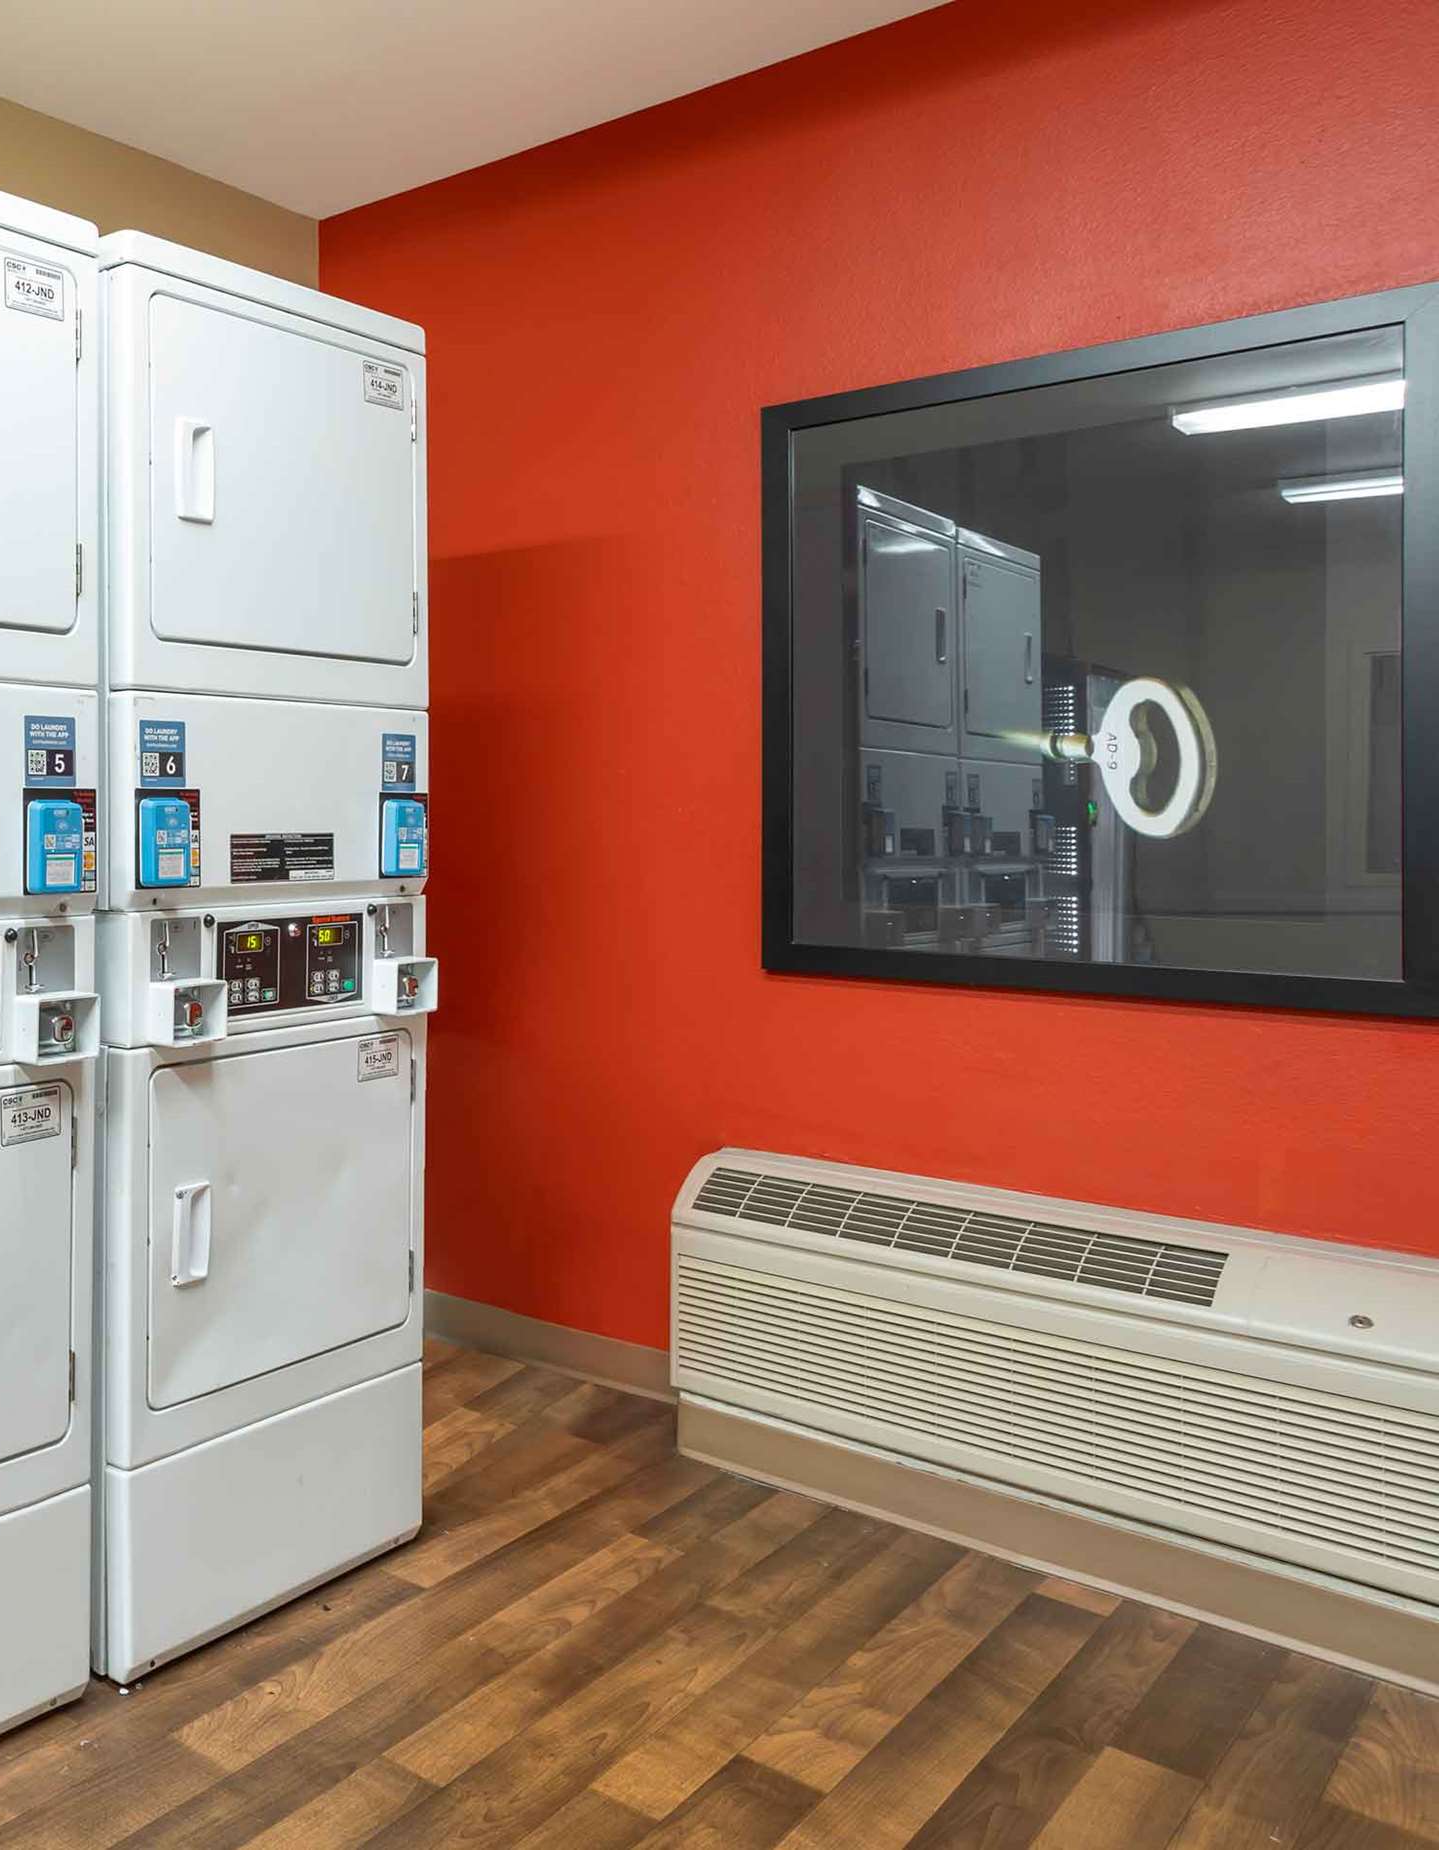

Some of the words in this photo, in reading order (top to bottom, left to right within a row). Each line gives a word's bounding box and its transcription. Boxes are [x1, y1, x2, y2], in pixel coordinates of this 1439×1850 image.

[6, 261, 22, 270] CSC
[14, 280, 55, 300] 412-JND
[370, 379, 397, 393] 414-JND
[1106, 733, 1118, 770] AD-9
[54, 753, 66, 774] 5
[166, 755, 176, 774] 6
[401, 764, 409, 781] 7
[83, 836, 95, 846] SA
[247, 936, 257, 949] 15
[319, 930, 331, 942] 50
[364, 1052, 392, 1064] 415-JND
[3, 1097, 18, 1105] CSC
[11, 1107, 51, 1124] 413-JND
